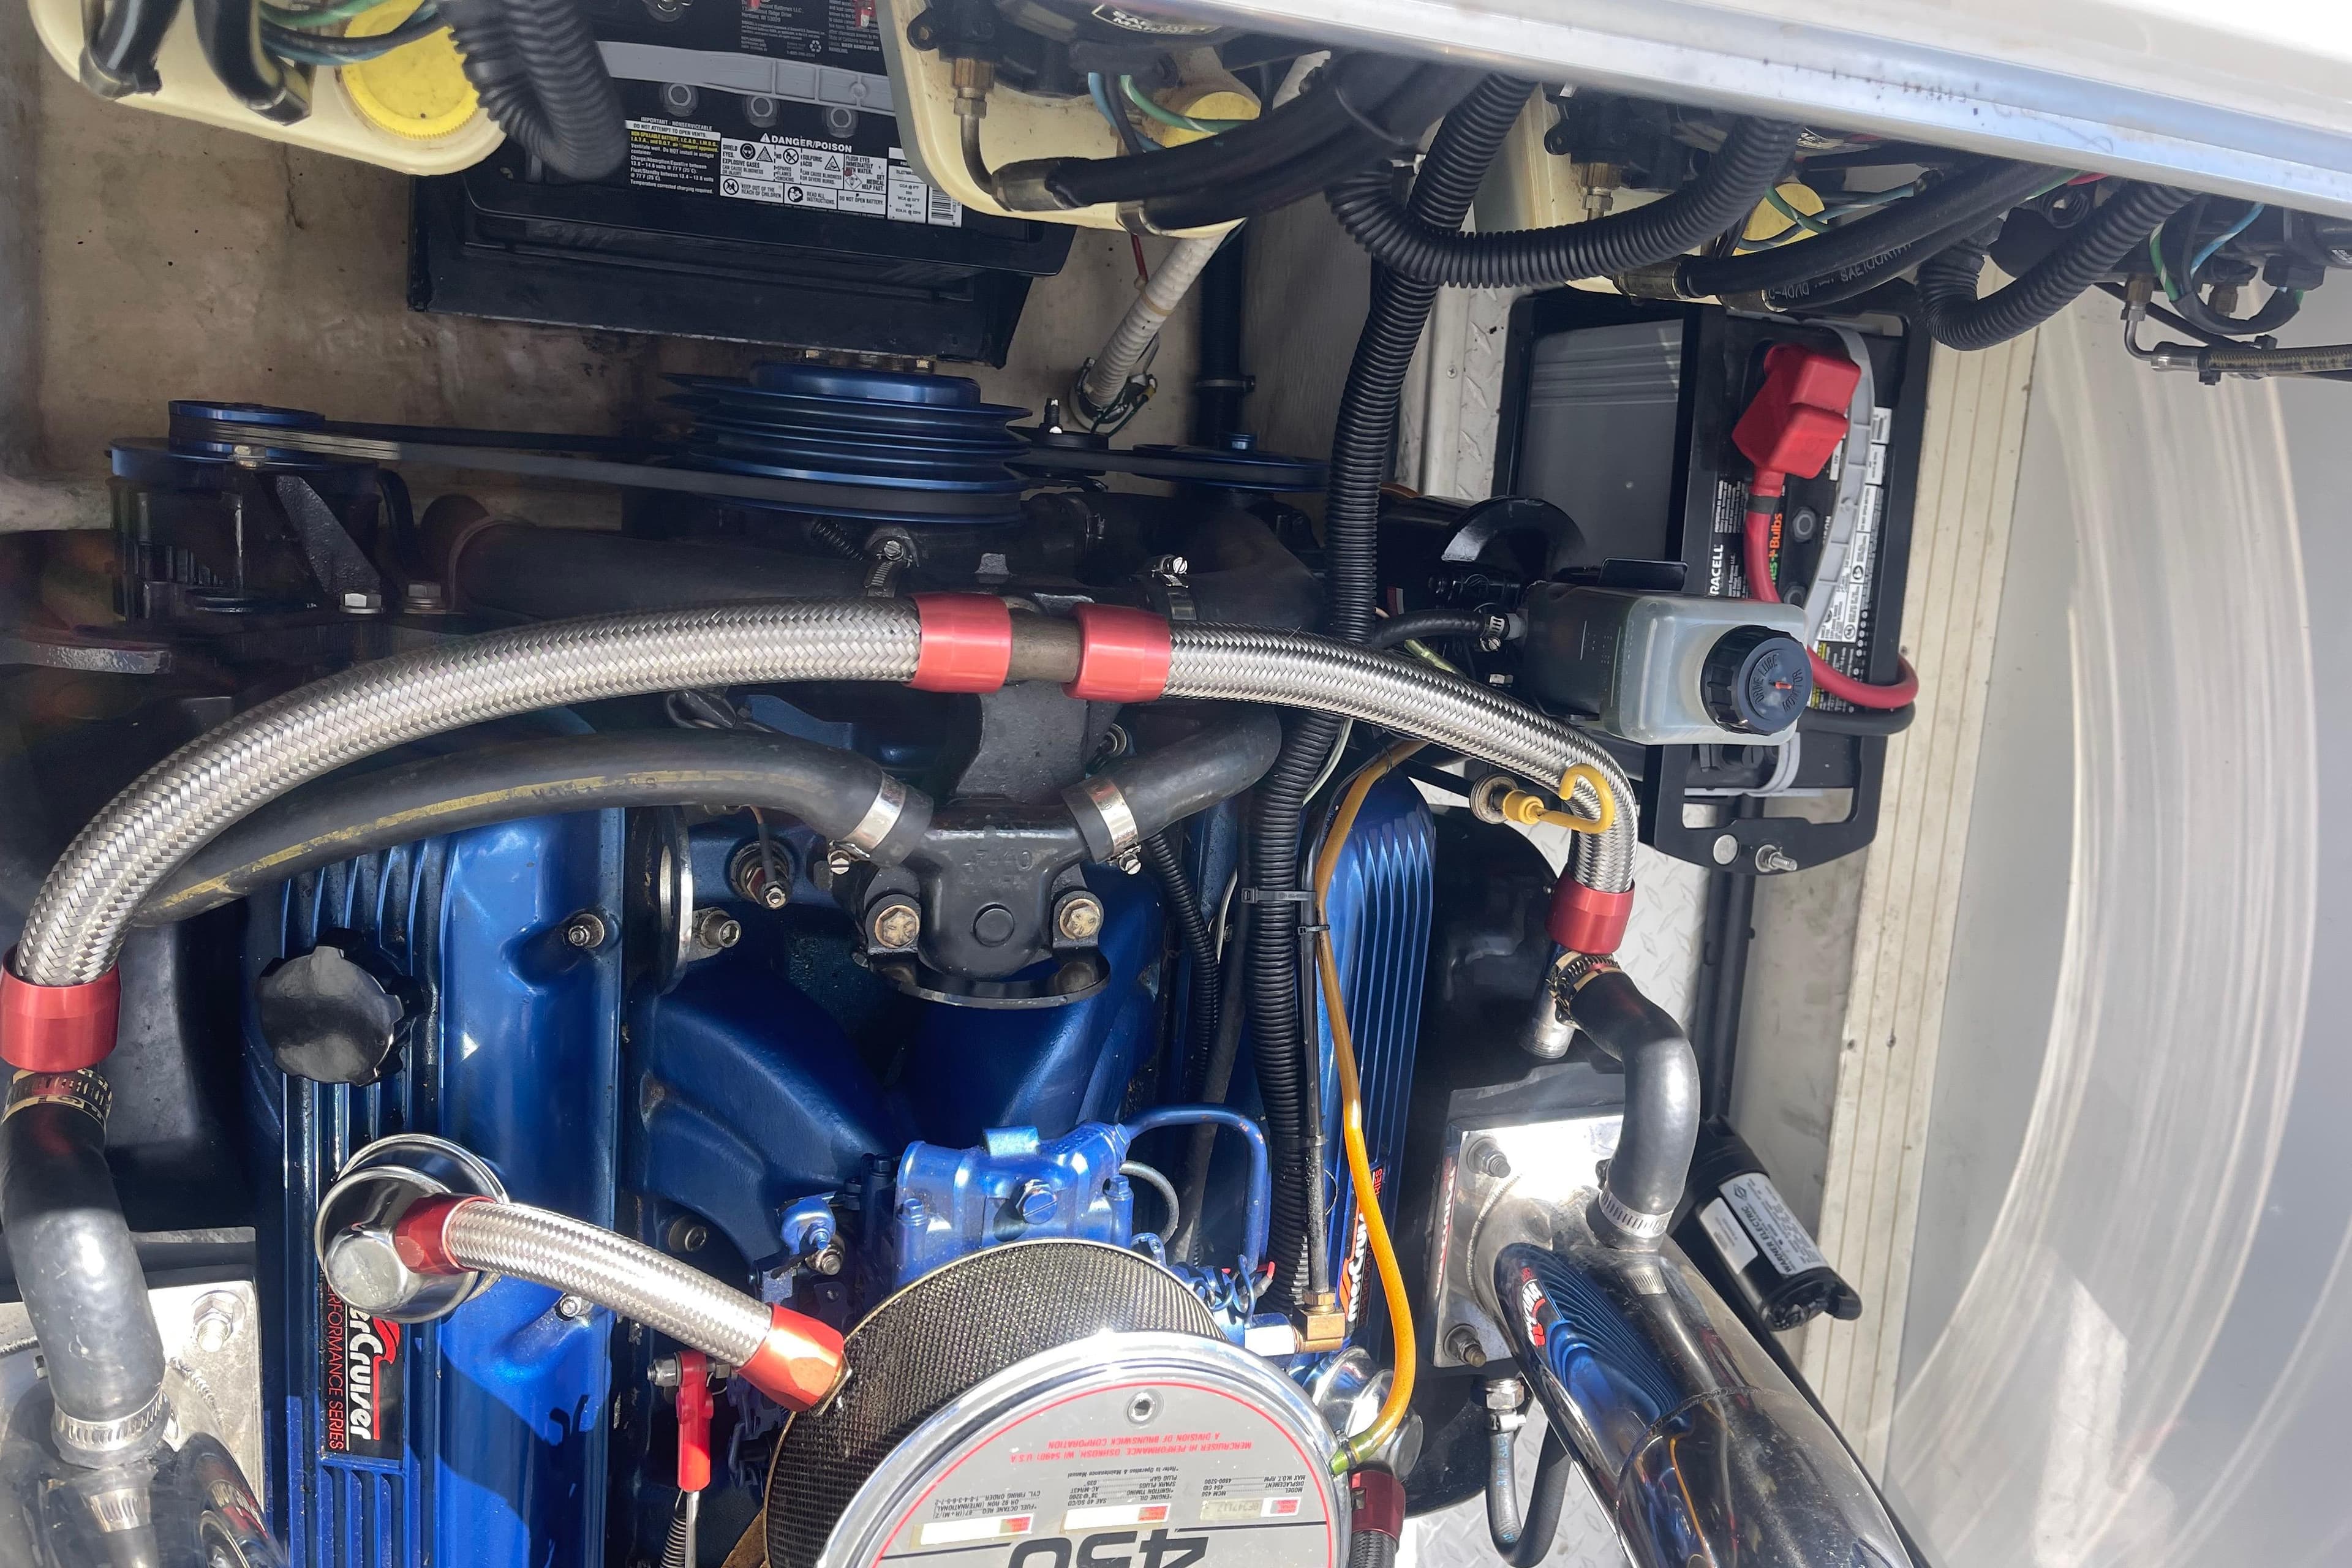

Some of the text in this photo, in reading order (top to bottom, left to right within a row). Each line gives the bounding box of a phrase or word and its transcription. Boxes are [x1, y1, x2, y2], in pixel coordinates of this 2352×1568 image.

[772, 135, 852, 153] DANGER/POISON
[1709, 545, 1724, 595] RACELL
[1752, 654, 1779, 704] DRIVE LUBE
[1741, 1205, 1792, 1273] WARNER ELECTRIC
[328, 1286, 344, 1450] RFORMANCE SERIES
[349, 1307, 383, 1440] erCruiser
[1047, 1438, 1107, 1449] CORPORATION
[1111, 1435, 1159, 1446] BRUNSWICK
[1177, 1433, 1212, 1442] DIVISION
[1200, 1441, 1252, 1452] MERCRUISER
[1126, 1445, 1186, 1456] PERFORMANCE
